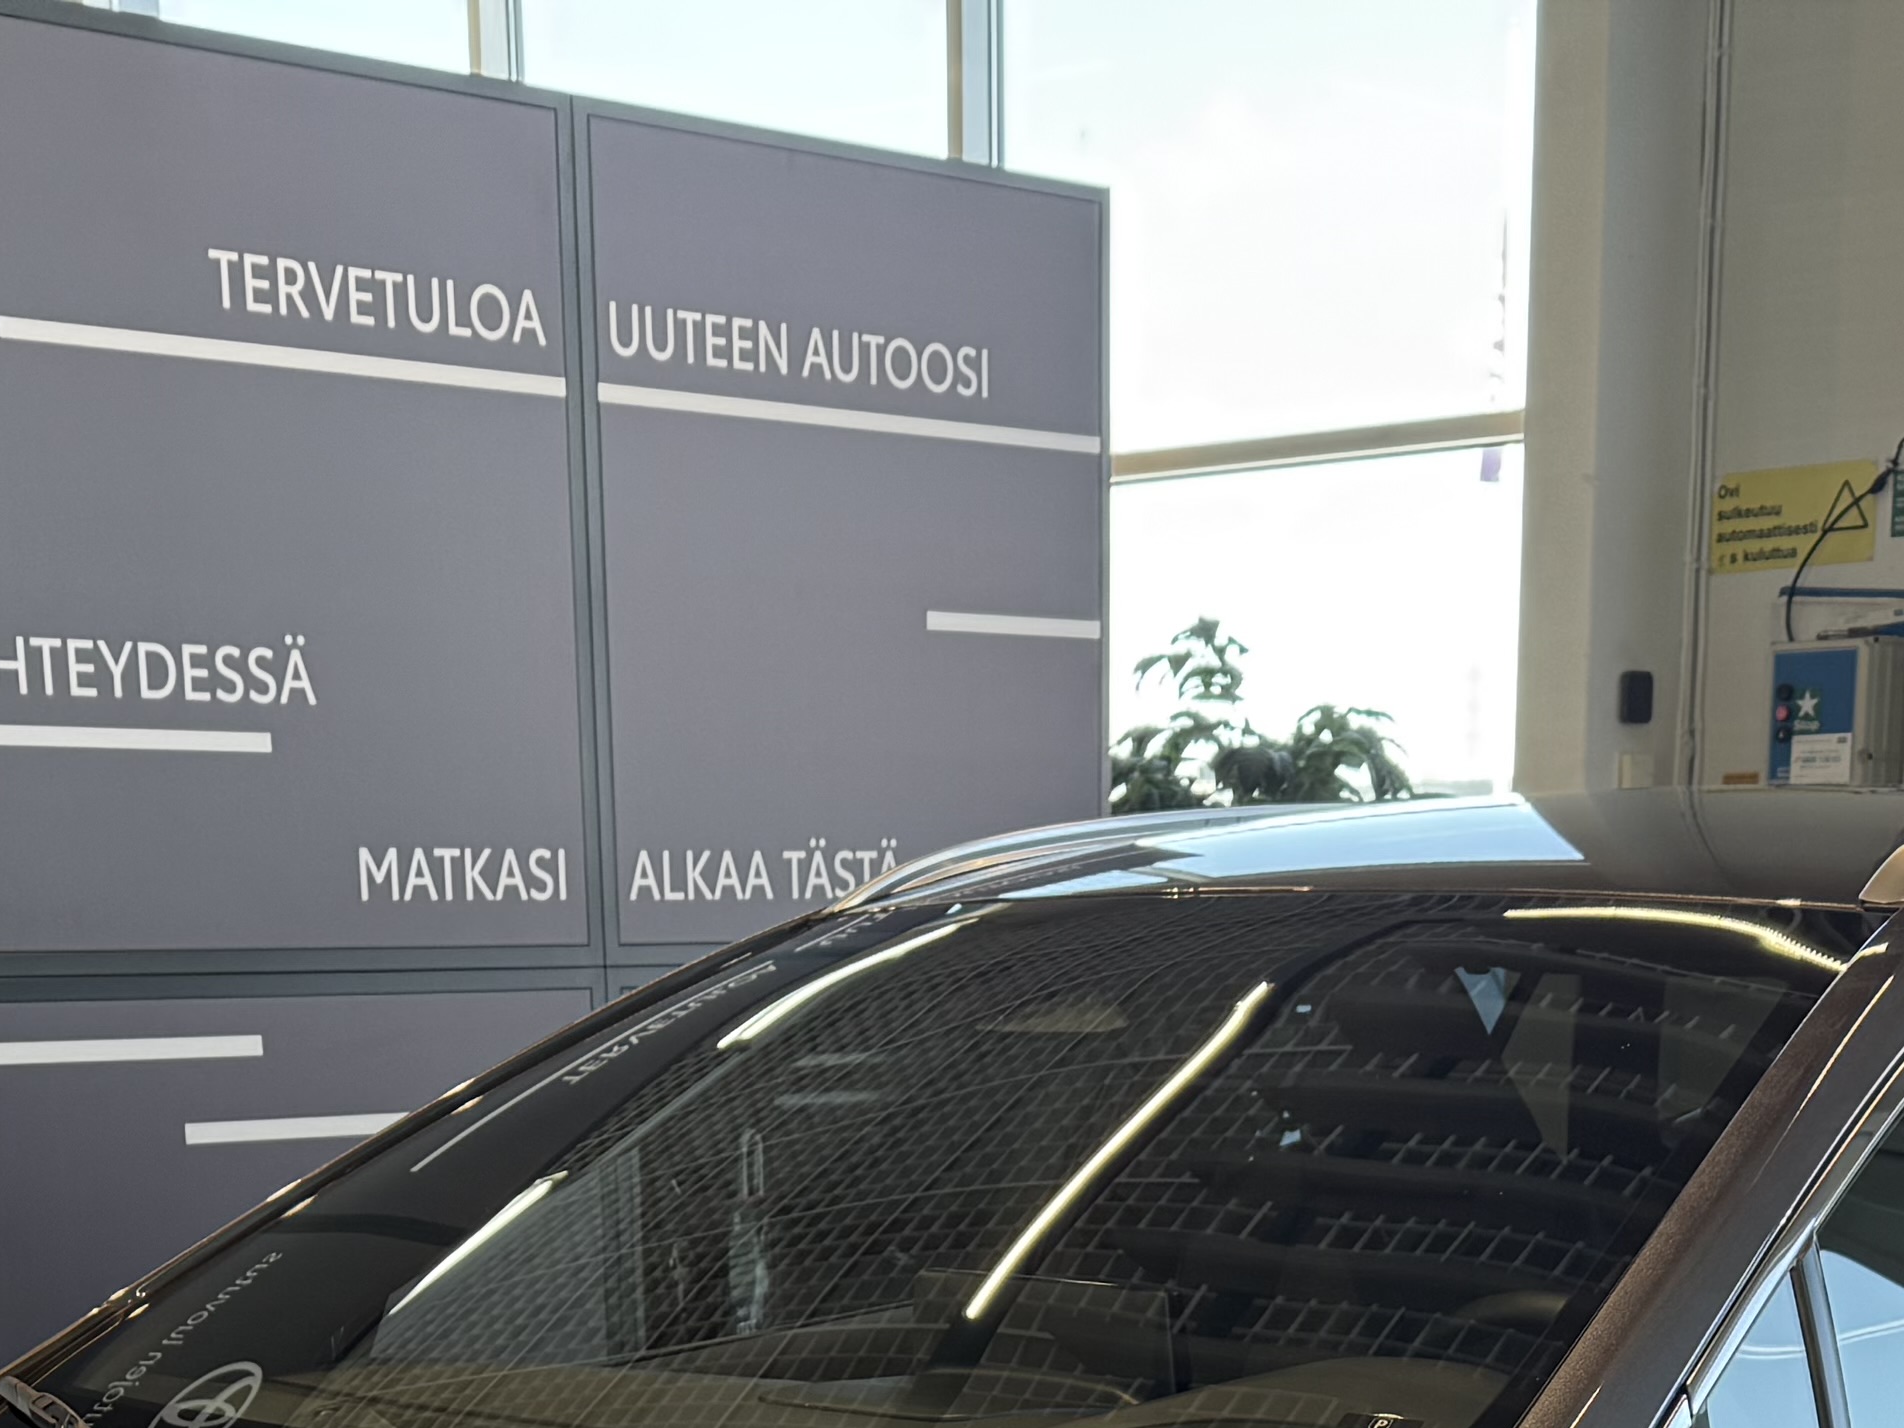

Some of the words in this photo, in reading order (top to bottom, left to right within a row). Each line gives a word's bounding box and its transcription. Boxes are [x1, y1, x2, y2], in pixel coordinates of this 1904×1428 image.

[208, 248, 547, 347] TERVETULOA
[608, 300, 789, 376] UUTEEN
[801, 326, 990, 399] AUTOOSI
[357, 846, 568, 903] MATKASI
[628, 848, 775, 903] ALKAA
